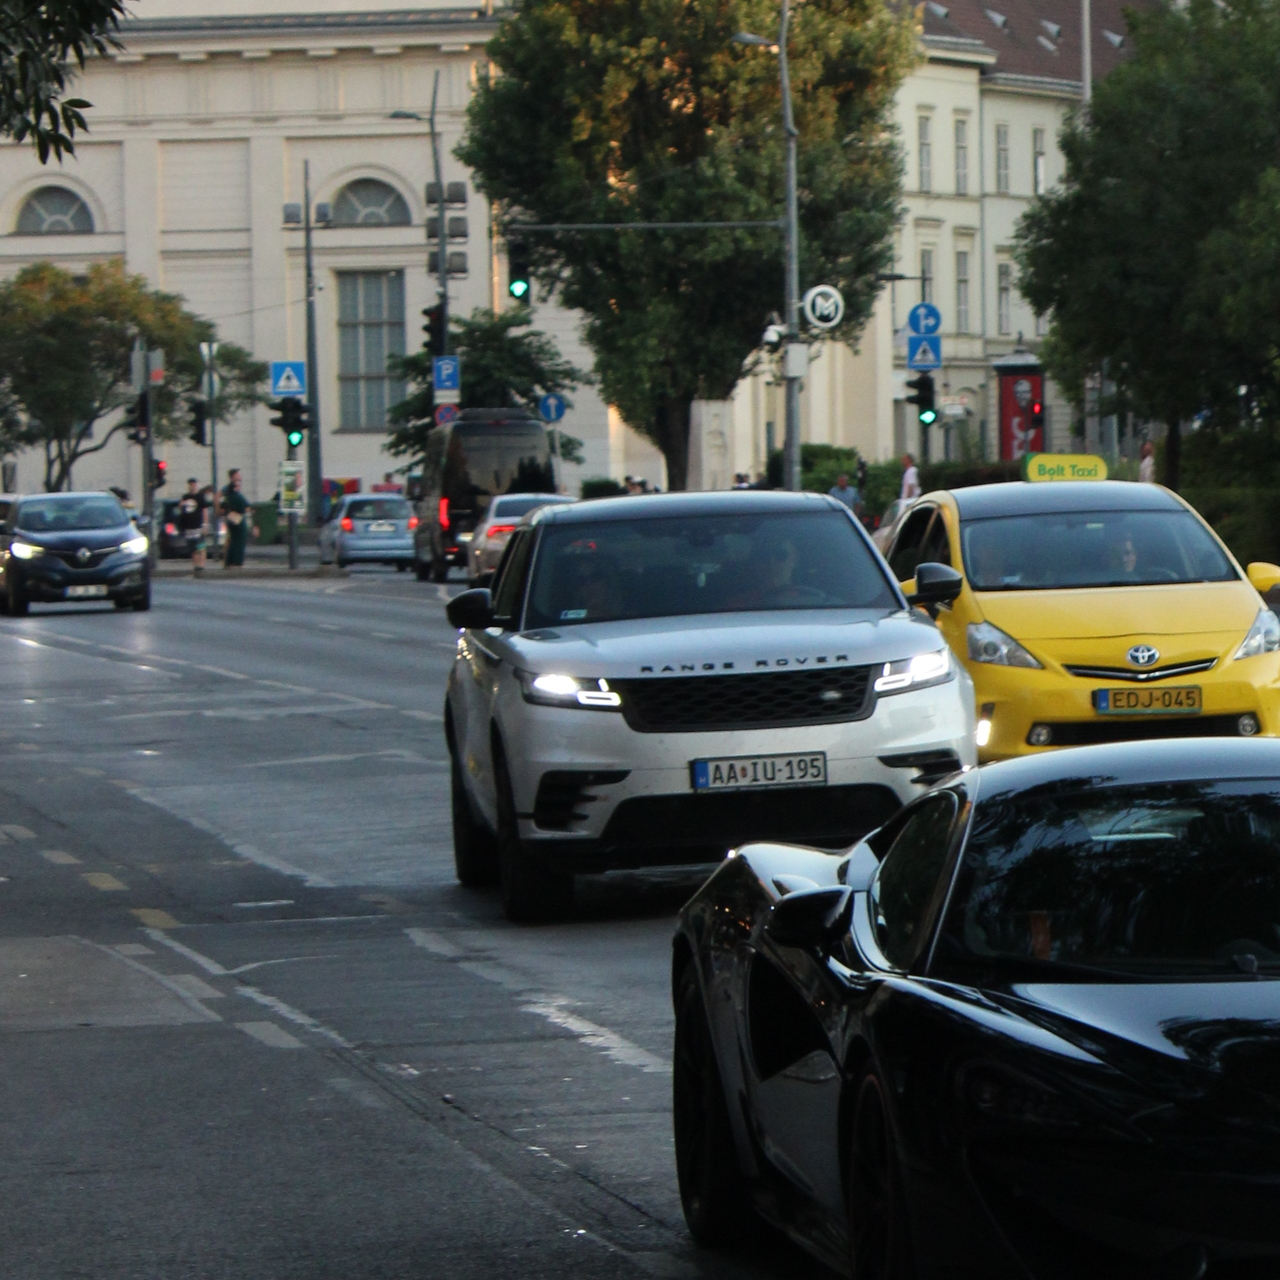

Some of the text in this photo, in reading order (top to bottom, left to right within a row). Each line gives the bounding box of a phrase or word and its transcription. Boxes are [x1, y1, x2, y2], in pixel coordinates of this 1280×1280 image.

[441, 364, 454, 380] P
[1038, 464, 1098, 477] Bolt Taxi
[640, 654, 848, 673] RANGE ROVER
[1113, 690, 1196, 709] EDJ-045
